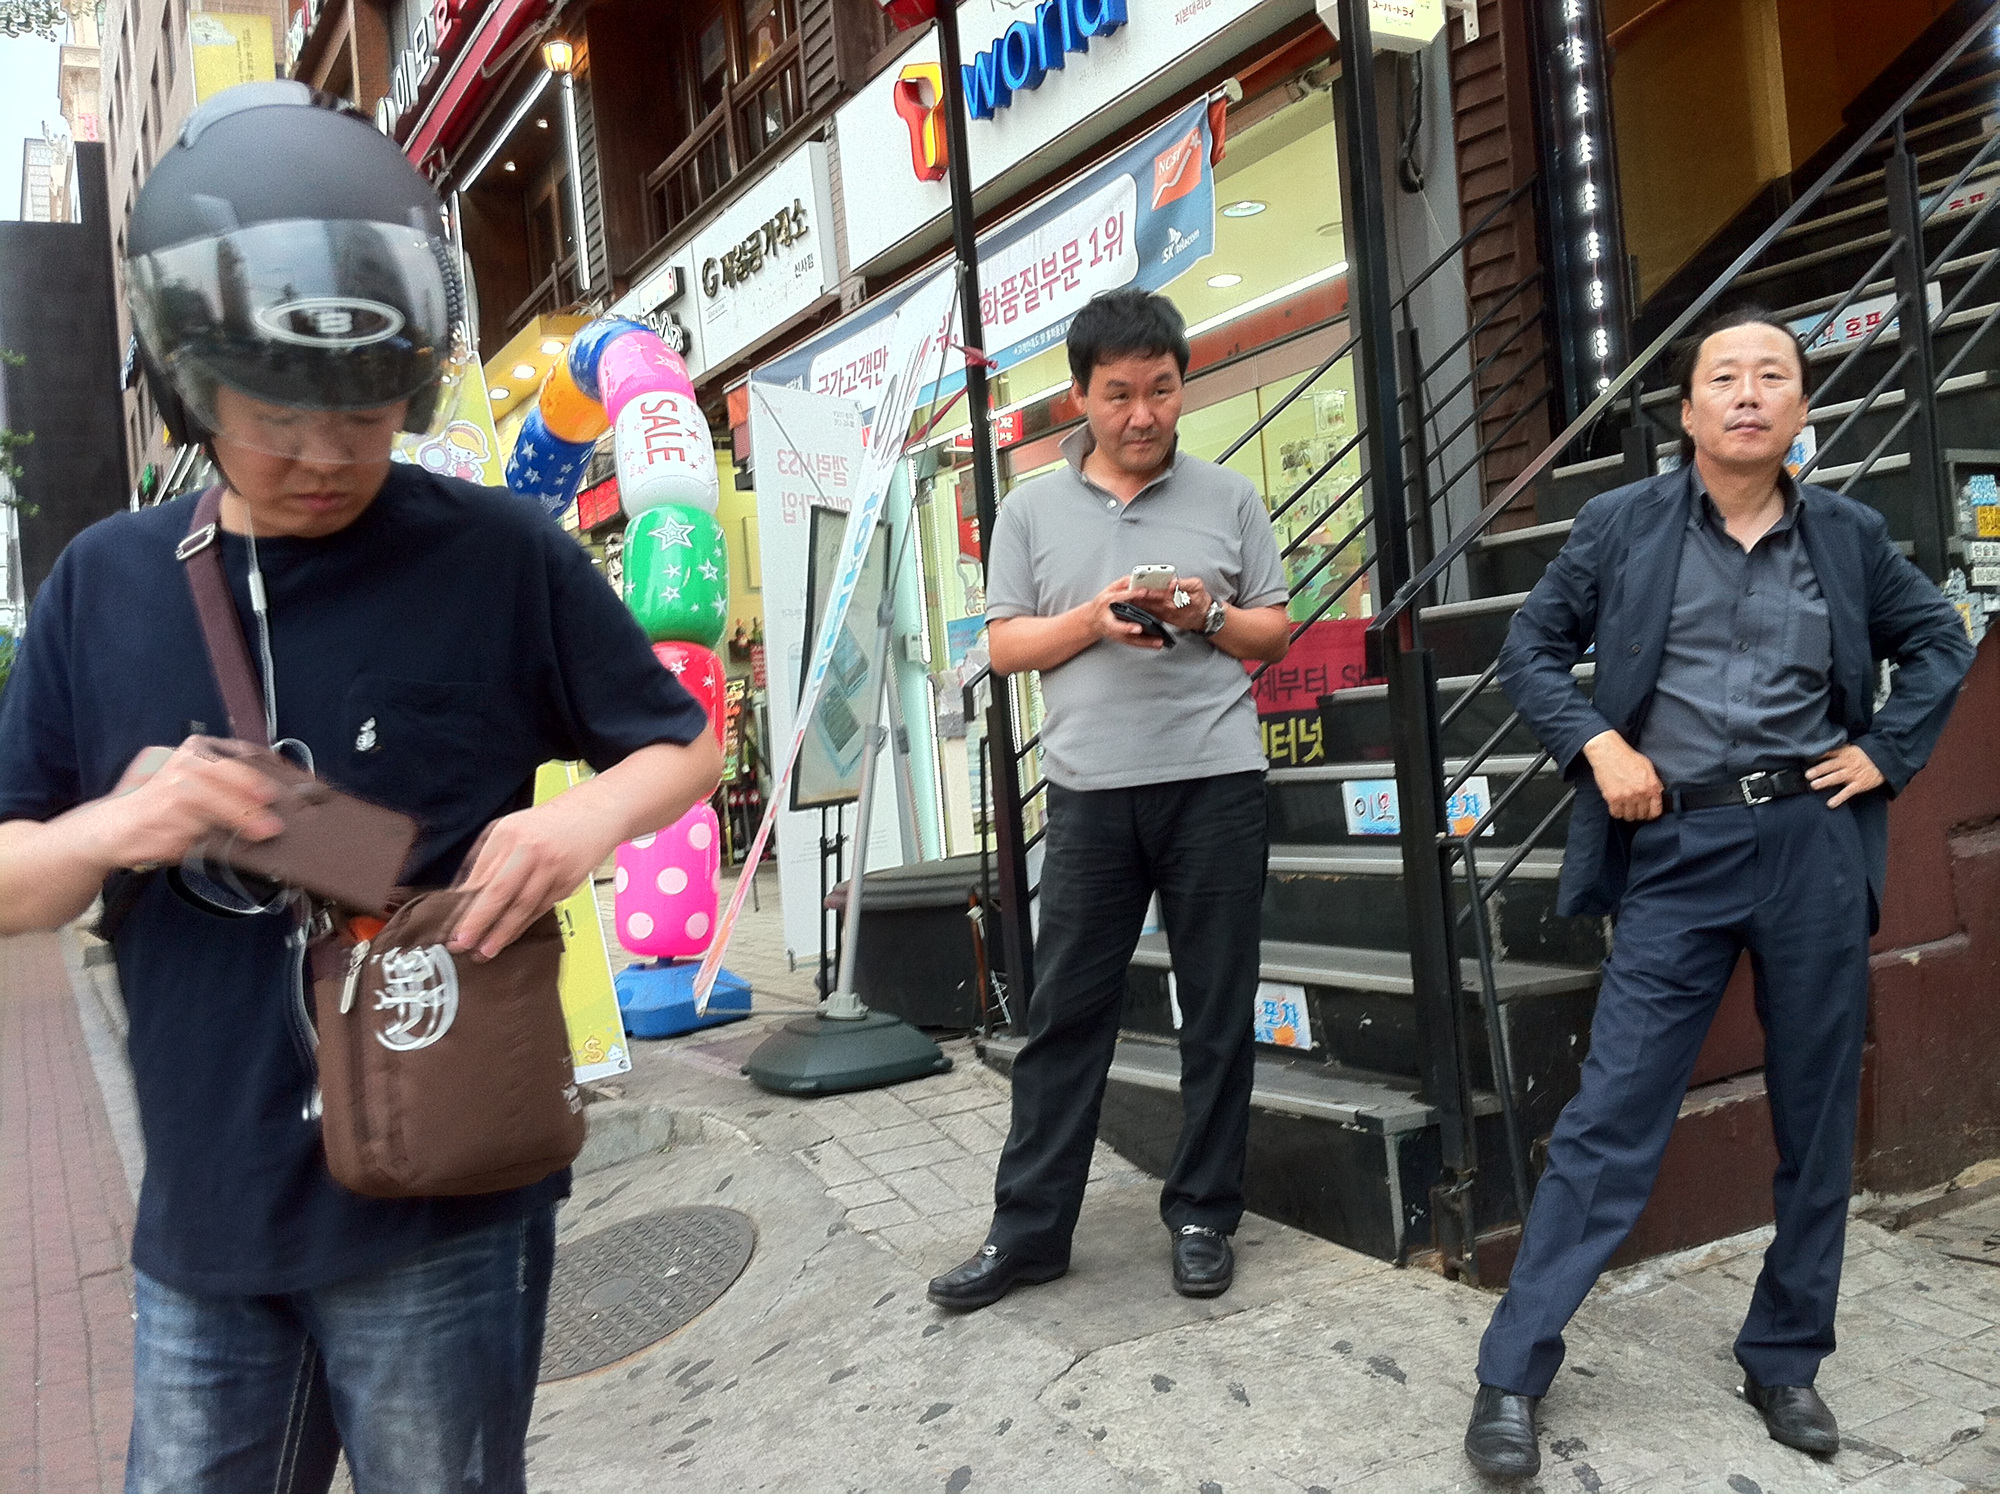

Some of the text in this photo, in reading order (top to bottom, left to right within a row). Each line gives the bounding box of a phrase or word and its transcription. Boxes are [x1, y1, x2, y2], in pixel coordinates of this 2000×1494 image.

[961, 0, 1128, 121] world
[1158, 147, 1182, 175] NCSI
[1088, 210, 1124, 268] 1위
[1161, 245, 1175, 265] SK
[702, 257, 720, 299] G
[640, 399, 686, 465] SALE
